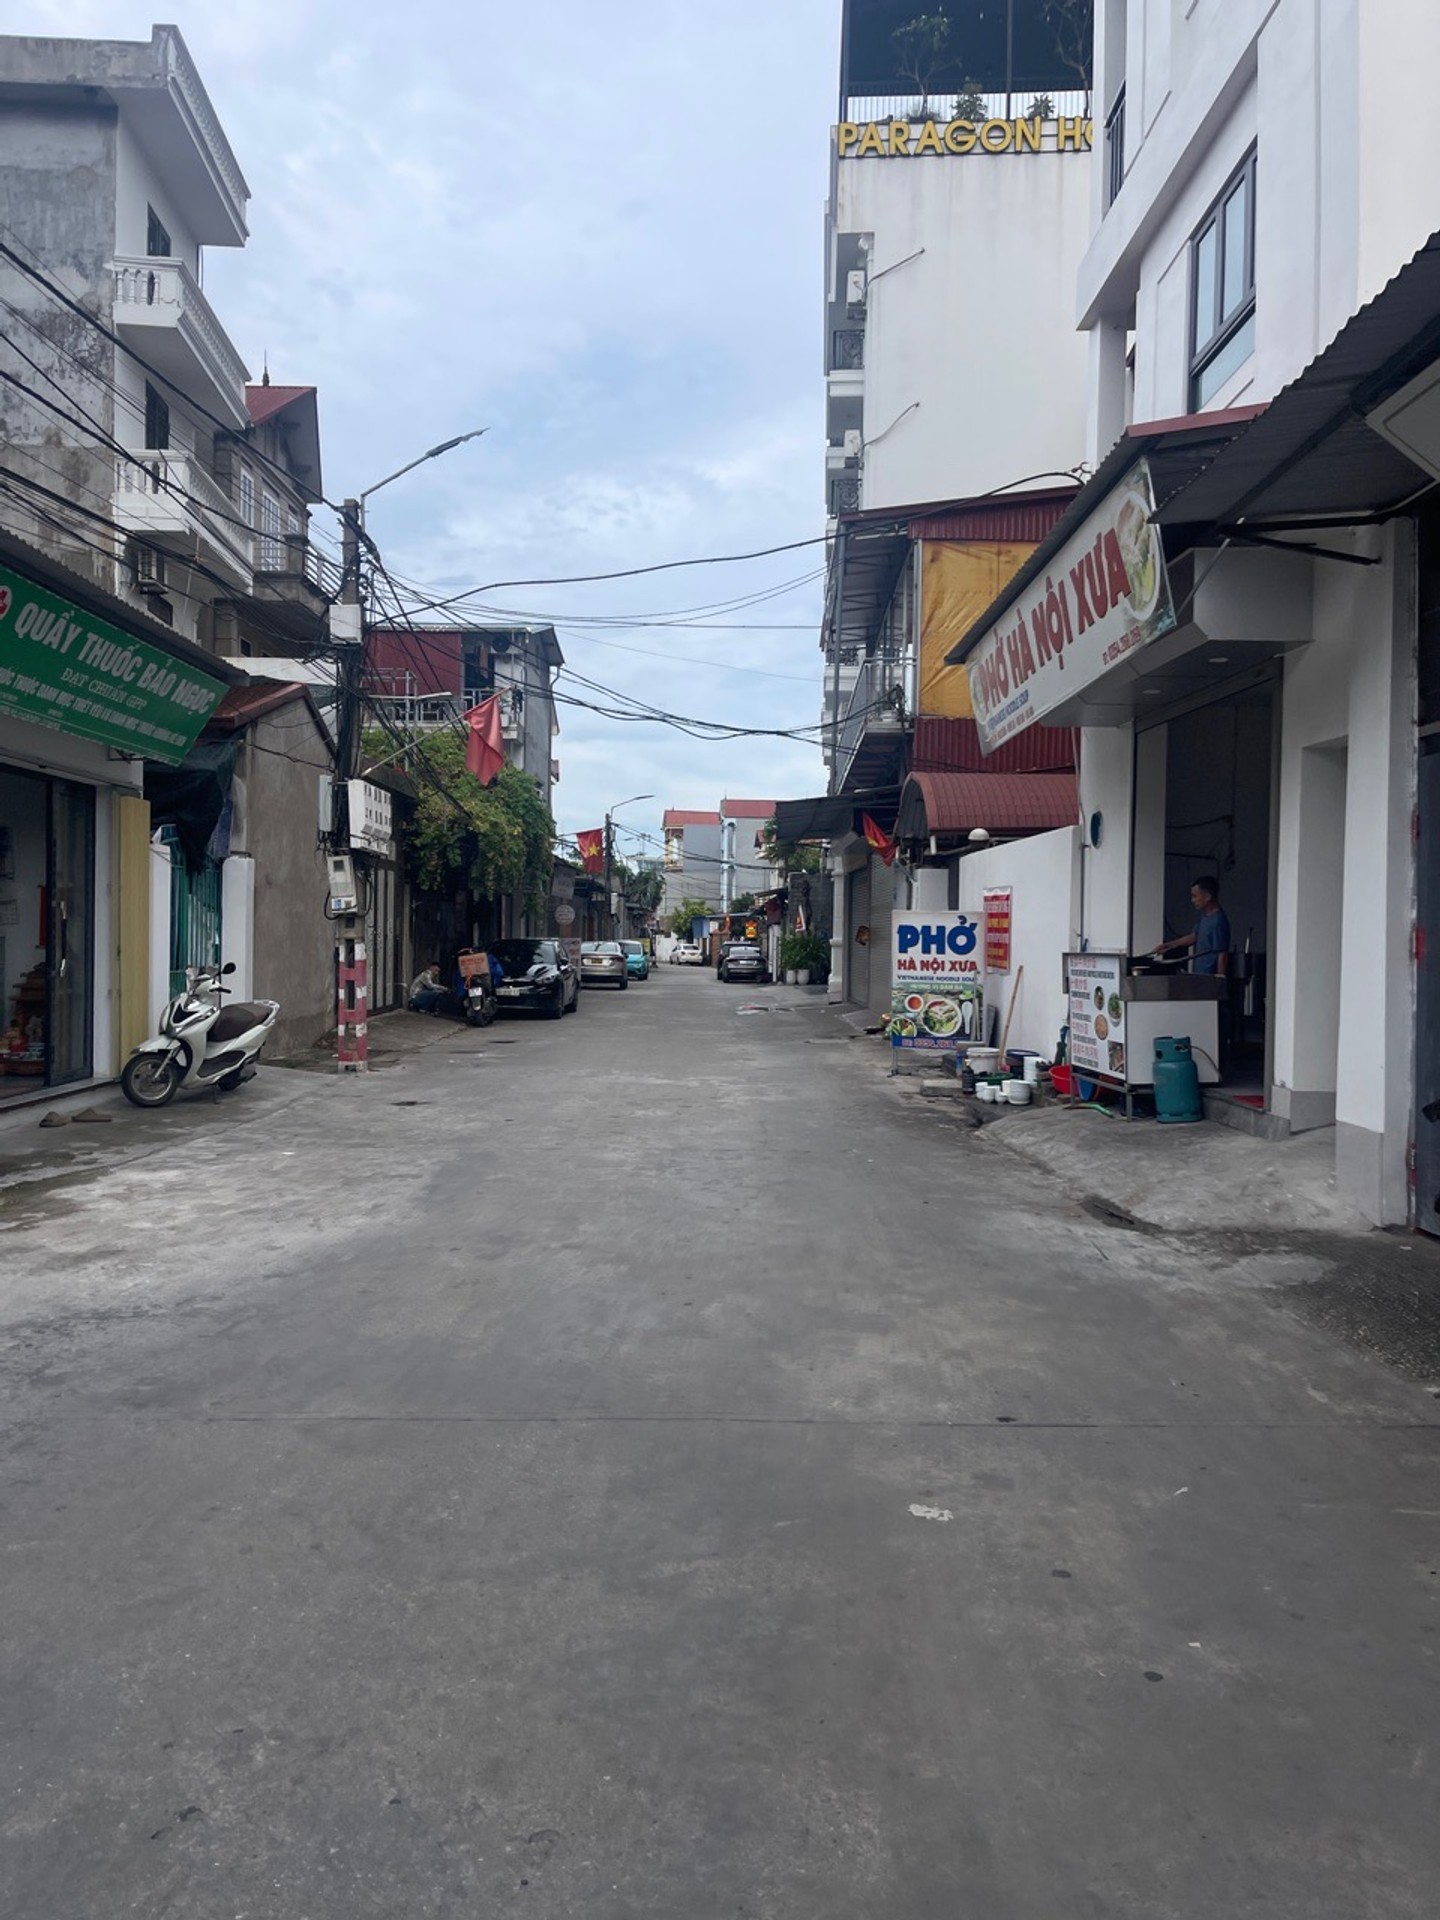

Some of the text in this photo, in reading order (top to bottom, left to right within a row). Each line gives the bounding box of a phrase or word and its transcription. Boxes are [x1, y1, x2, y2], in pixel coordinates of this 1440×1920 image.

[838, 116, 1092, 159] PARAGON H
[978, 627, 1009, 713] PHỞ
[1006, 608, 1036, 688] HÀ
[1031, 576, 1073, 670] NỘI
[1068, 527, 1132, 635] XƯA
[60, 668, 89, 688] ĐẠT
[78, 632, 143, 682] THUỐC
[137, 658, 177, 697] BẢO
[175, 677, 216, 715] NGỌC
[897, 915, 978, 955] PHỞ
[897, 957, 917, 971] HÀ
[920, 957, 945, 974] NỘI
[948, 958, 978, 972] XƯA
